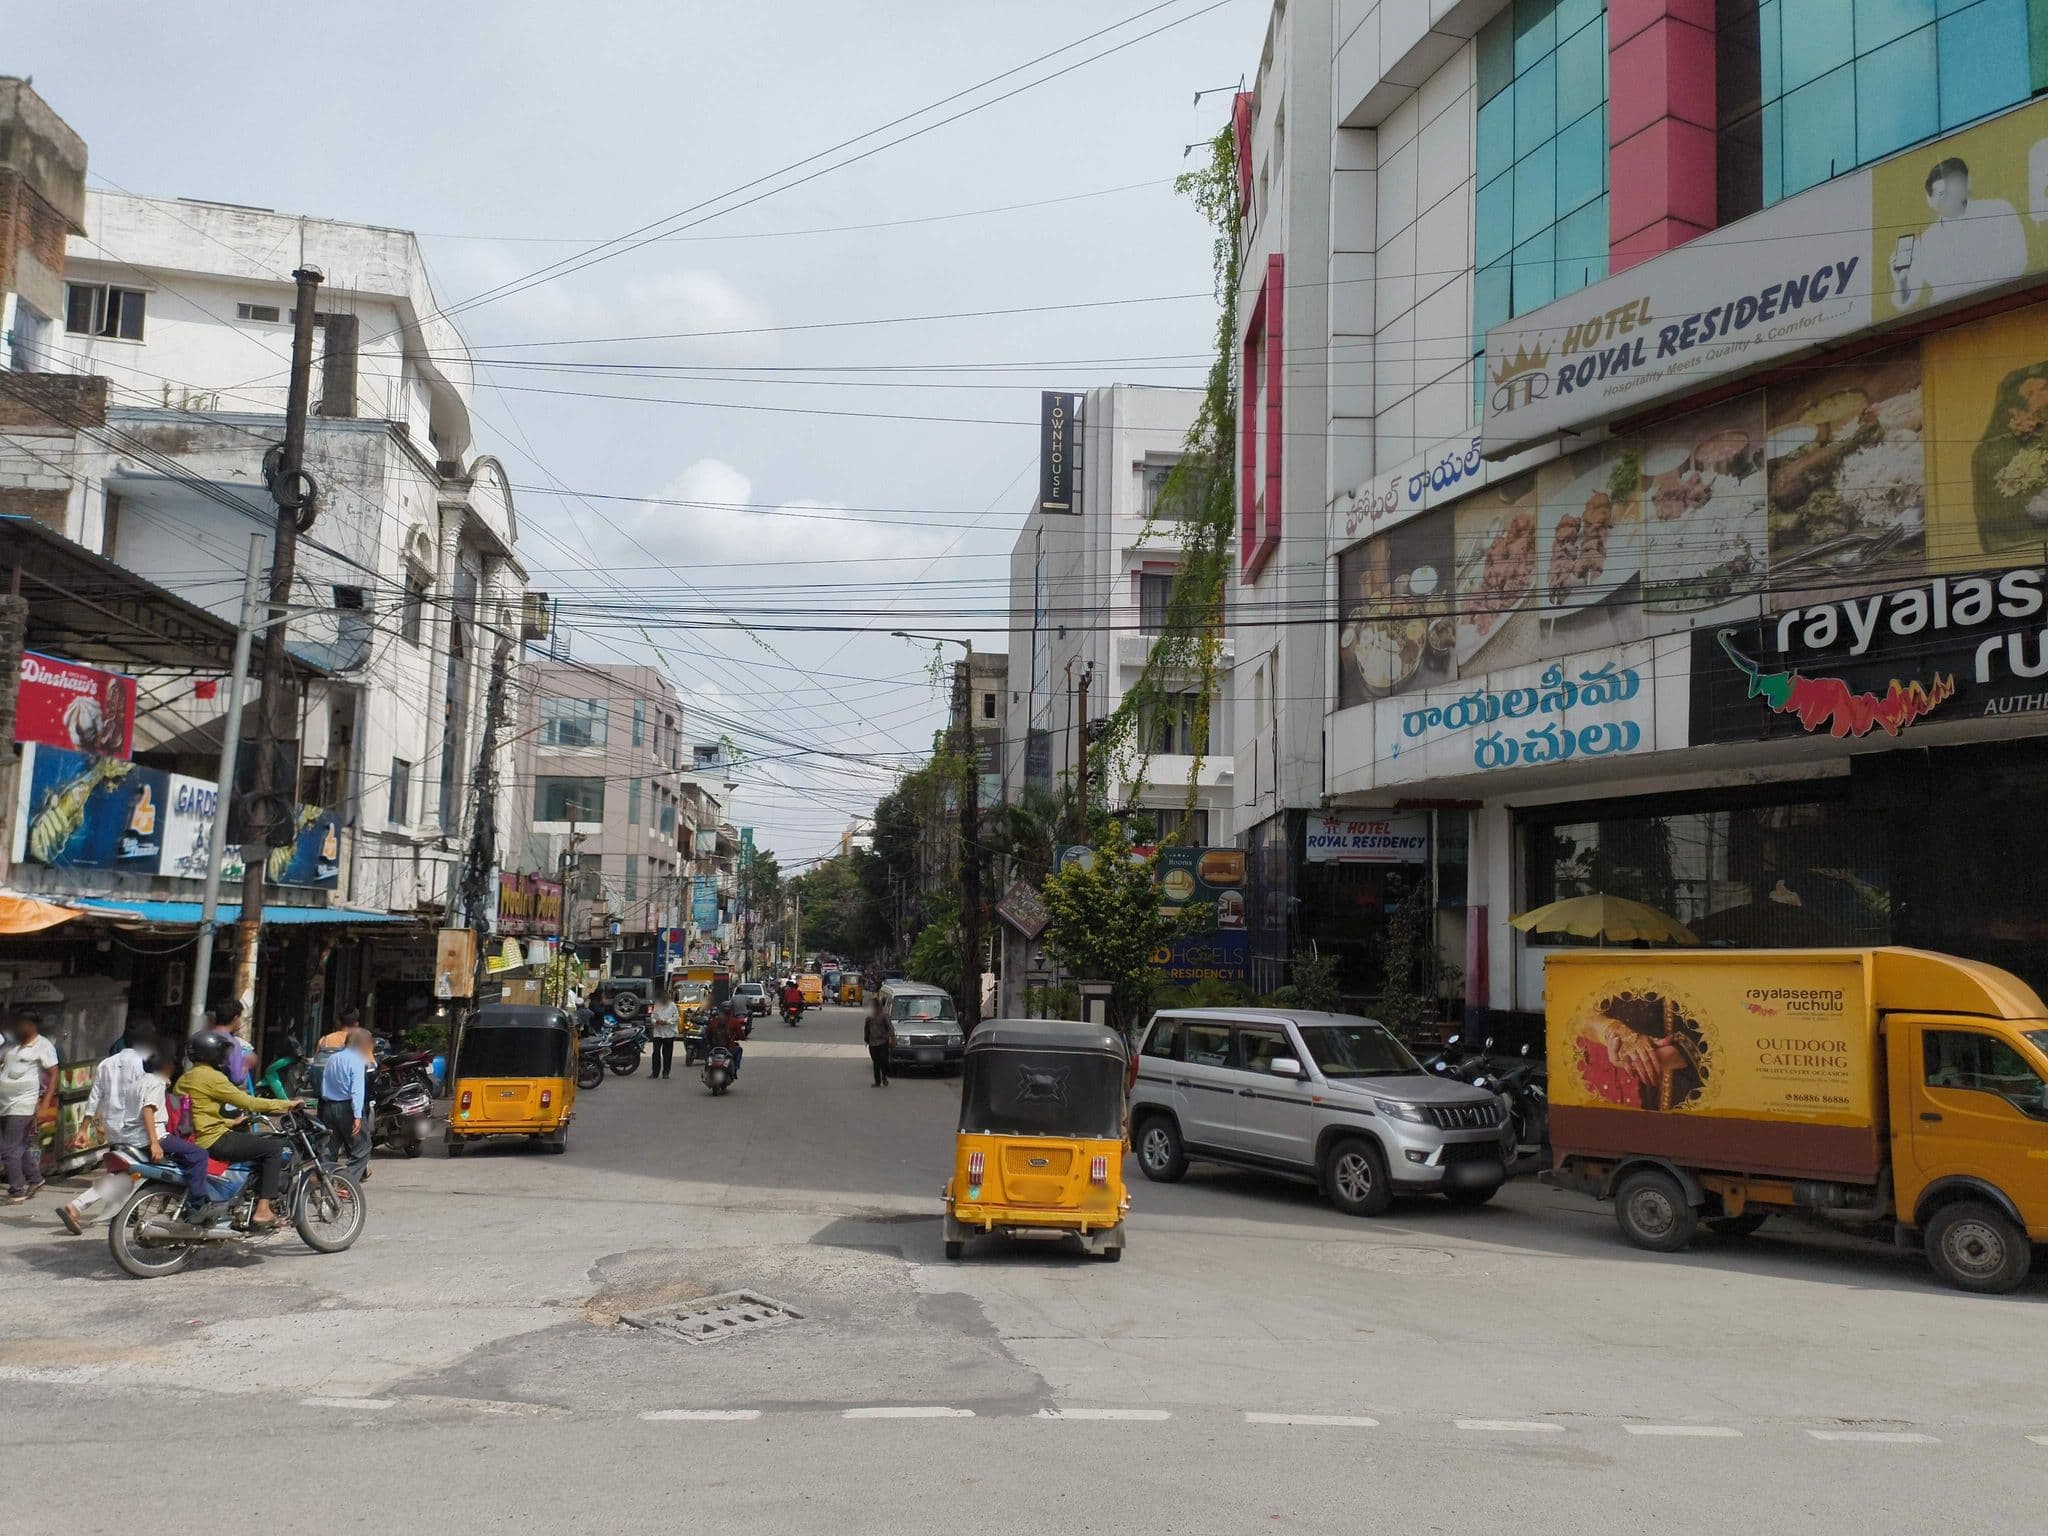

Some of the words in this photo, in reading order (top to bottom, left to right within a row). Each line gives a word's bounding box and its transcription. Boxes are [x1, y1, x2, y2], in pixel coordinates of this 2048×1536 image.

[1556, 337, 1646, 395] ROYAL
[1657, 256, 1859, 358] RESIDENCY
[1562, 296, 1652, 357] HOTEL
[1603, 370, 1663, 397] Hospitality
[1667, 353, 1701, 376] Meets
[1706, 339, 1750, 361] Quality
[1755, 333, 1763, 343] &
[1051, 396, 1064, 498] TOWNHOUSE
[1408, 436, 1481, 502] రాయల్
[20, 658, 98, 695] Dinshaw's
[1403, 661, 1640, 737] రాయలసీమ
[1474, 720, 1641, 768] రుచులు
[1347, 821, 1391, 834] HOTEL
[1308, 835, 1348, 847] ROYAL
[1352, 836, 1425, 848] RESIDENCY
[1168, 858, 1193, 866] Rooms
[1171, 968, 1234, 979] RESIDENCY
[1746, 988, 1843, 1001] rayalaseema
[1787, 1000, 1843, 1011] ruchulu
[1756, 1038, 1847, 1053] OUTDOOR
[1759, 1053, 1847, 1069] CATERING
[1793, 1094, 1820, 1102] 86886
[1822, 1096, 1849, 1104] 86886
